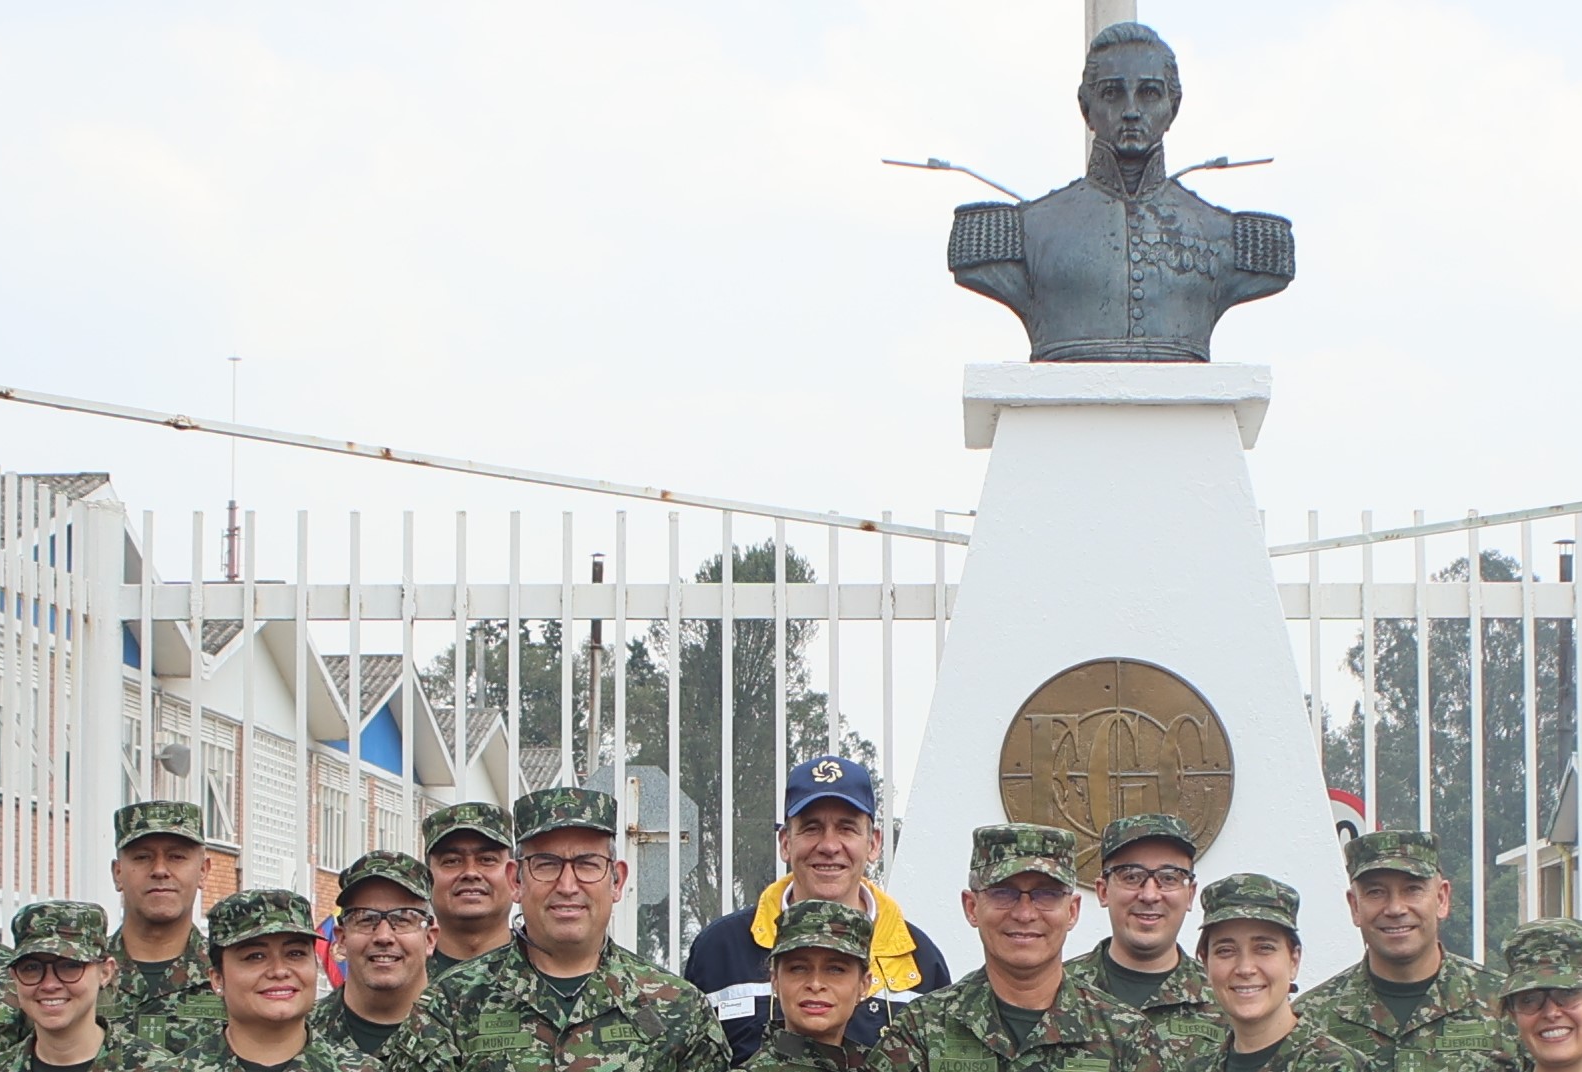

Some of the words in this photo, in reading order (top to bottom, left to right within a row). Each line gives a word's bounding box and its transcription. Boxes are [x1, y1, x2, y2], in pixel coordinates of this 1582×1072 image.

[609, 1026, 635, 1040] EJER
[482, 1034, 516, 1049] MUÑOZ
[1442, 1038, 1490, 1050] EJERCITO
